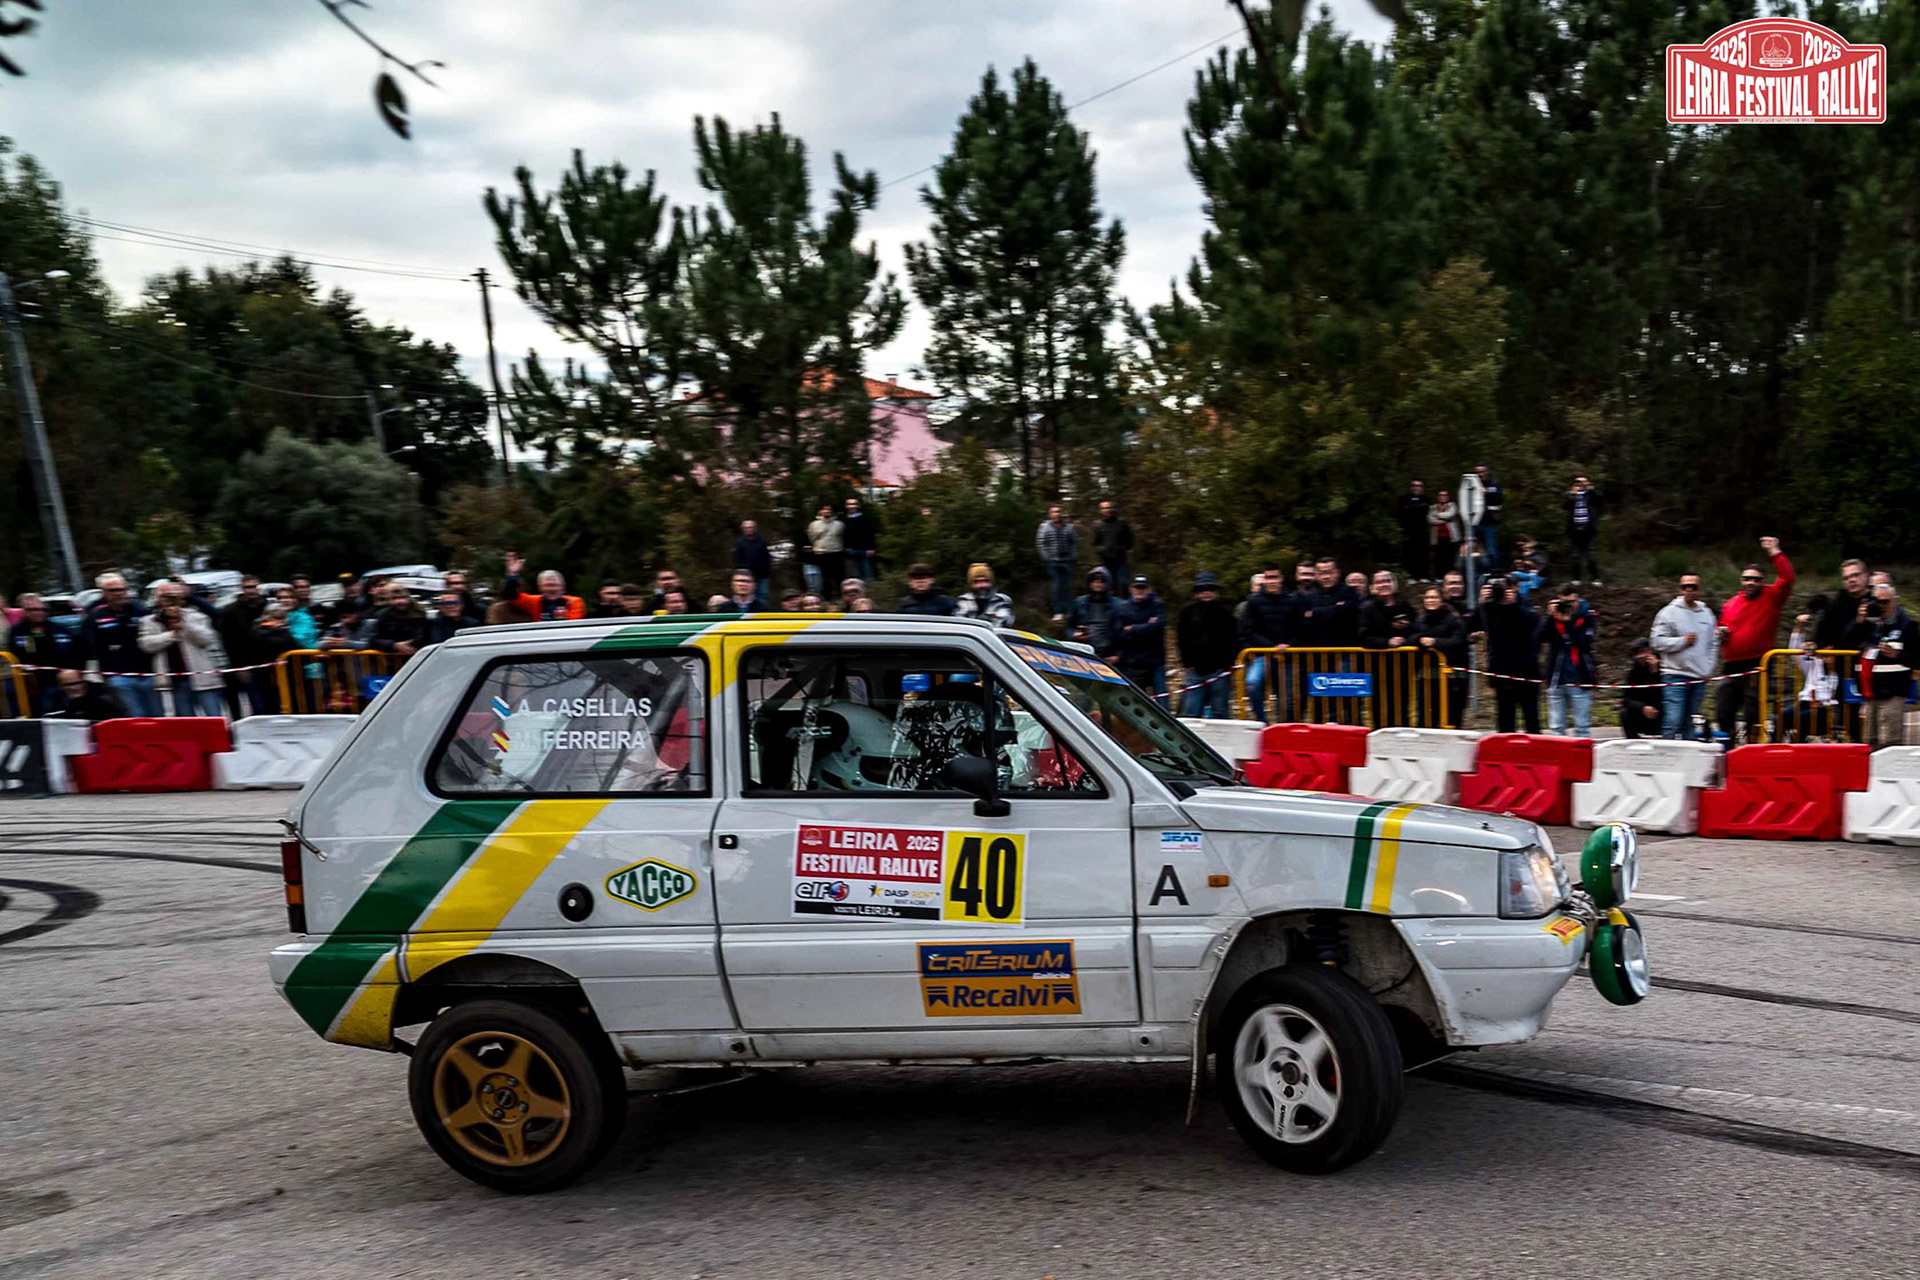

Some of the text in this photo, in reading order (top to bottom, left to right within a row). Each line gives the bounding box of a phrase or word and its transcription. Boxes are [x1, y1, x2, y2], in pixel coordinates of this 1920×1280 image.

[542, 698, 652, 718] CASELLAS
[542, 730, 647, 750] FERREIRA
[829, 830, 900, 851] LEIRIA
[906, 835, 940, 852] 2025
[1160, 831, 1203, 843] SEAT
[800, 853, 939, 878] FESTIVAL RALLYE
[613, 865, 686, 905] YACCO
[950, 836, 1017, 920] 40
[1148, 864, 1190, 906] A
[795, 881, 830, 900] elf
[884, 889, 909, 898] DASP
[952, 983, 1050, 1008] Recalvi
